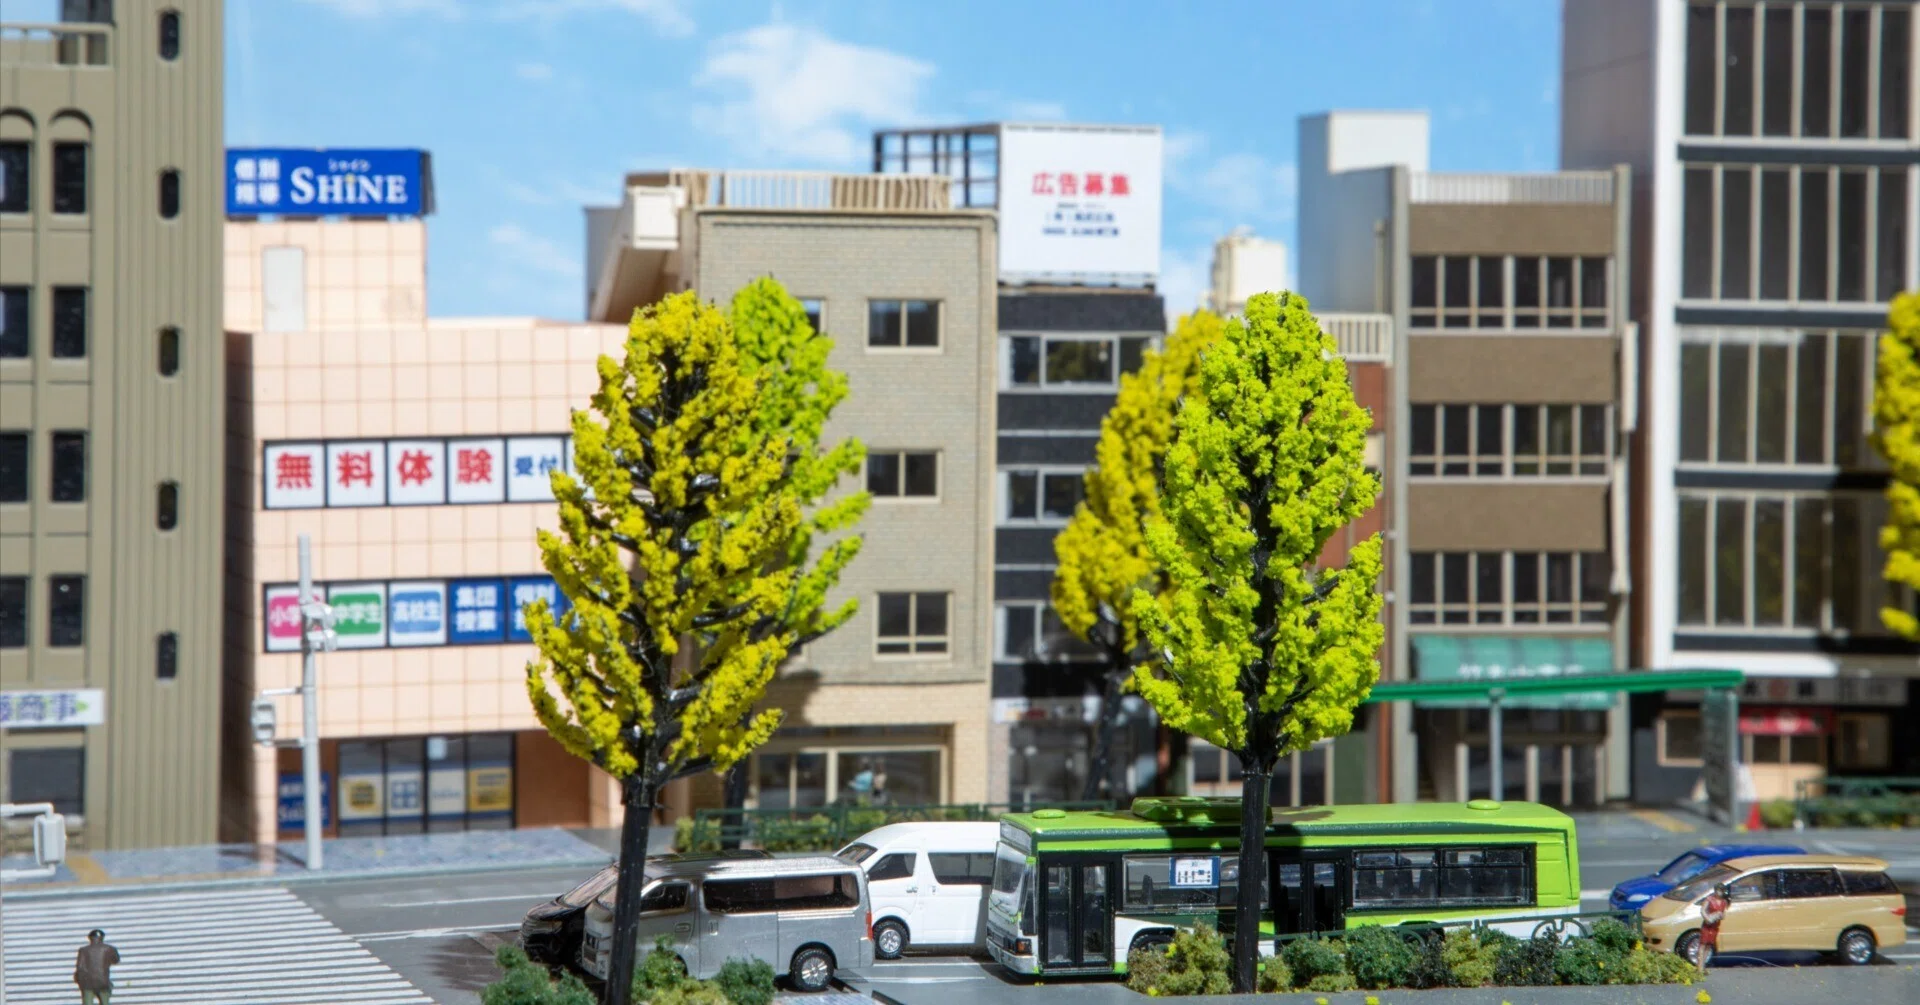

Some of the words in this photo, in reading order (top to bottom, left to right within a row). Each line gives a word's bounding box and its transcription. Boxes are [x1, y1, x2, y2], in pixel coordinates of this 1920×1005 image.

[234, 157, 281, 181] 個別
[234, 182, 281, 205] 指導
[1032, 172, 1130, 197] 広告募集
[276, 449, 493, 489] 無料体験
[456, 585, 498, 608] 集団
[334, 601, 381, 624] 中学生
[393, 600, 440, 623] 高校生
